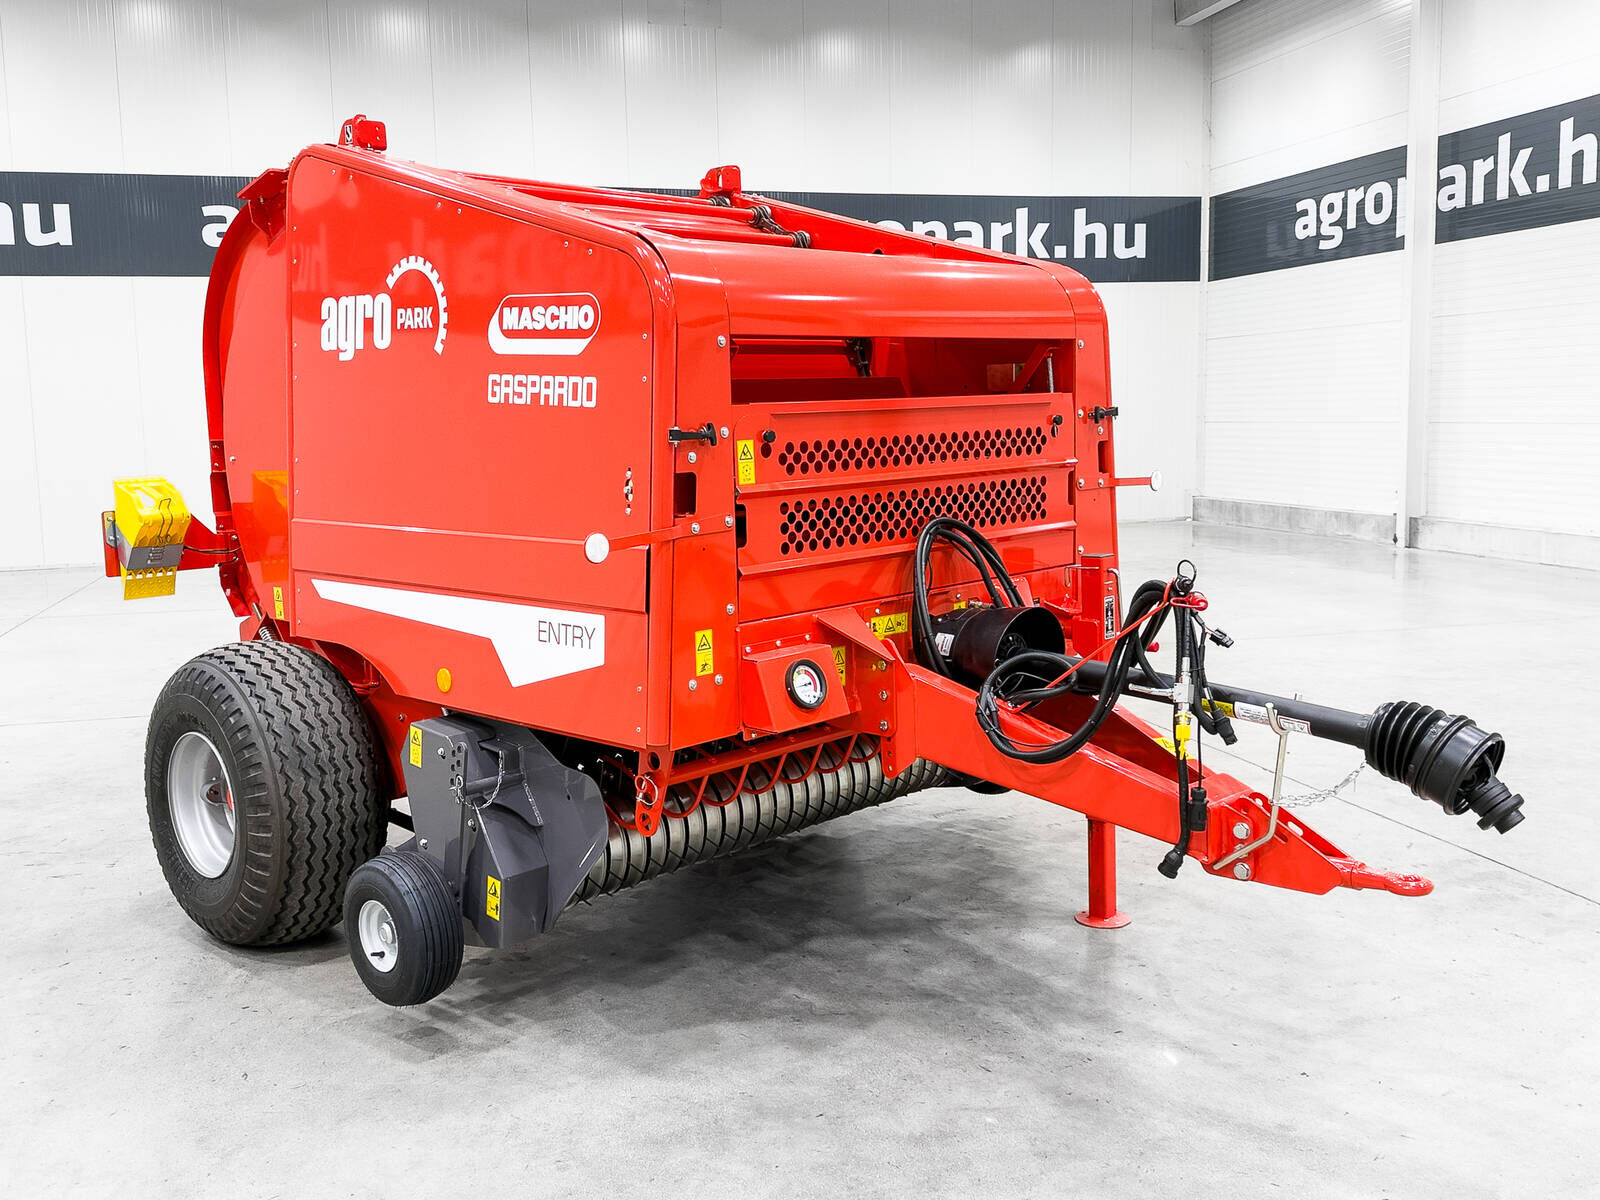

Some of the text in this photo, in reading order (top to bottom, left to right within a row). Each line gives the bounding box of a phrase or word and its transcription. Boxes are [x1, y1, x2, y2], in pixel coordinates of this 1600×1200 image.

[320, 293, 433, 361] agro PARK
[502, 304, 595, 331] MASCHIO
[488, 373, 597, 408] GASPARDO
[538, 620, 596, 649] ENTRY
